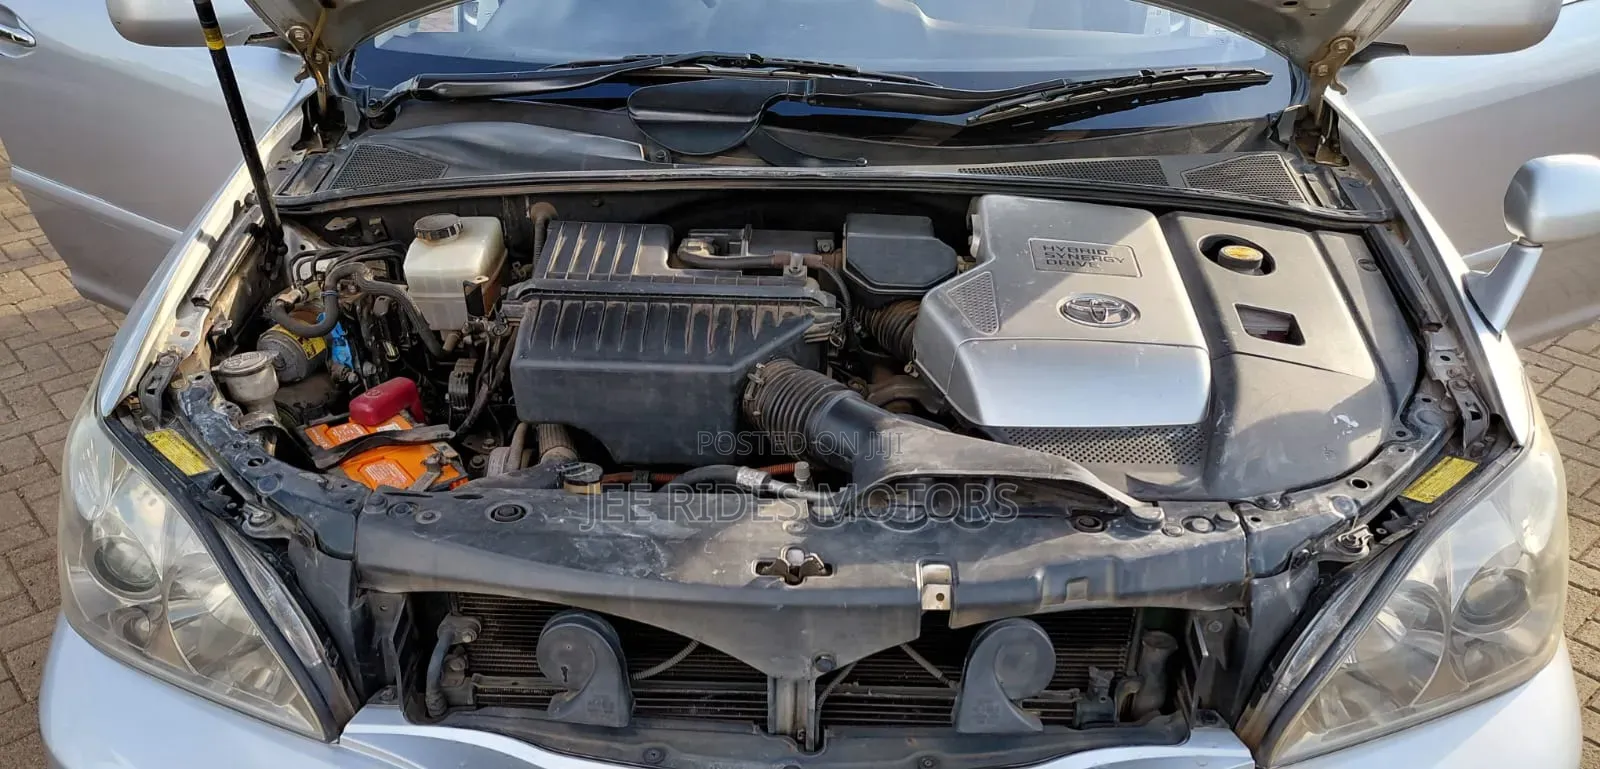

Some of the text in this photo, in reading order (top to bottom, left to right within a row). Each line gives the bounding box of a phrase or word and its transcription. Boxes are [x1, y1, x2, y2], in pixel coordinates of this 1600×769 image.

[1042, 245, 1108, 256] HYBRID
[1044, 252, 1125, 264] SYNERGY
[1046, 260, 1100, 269] DRIVE
